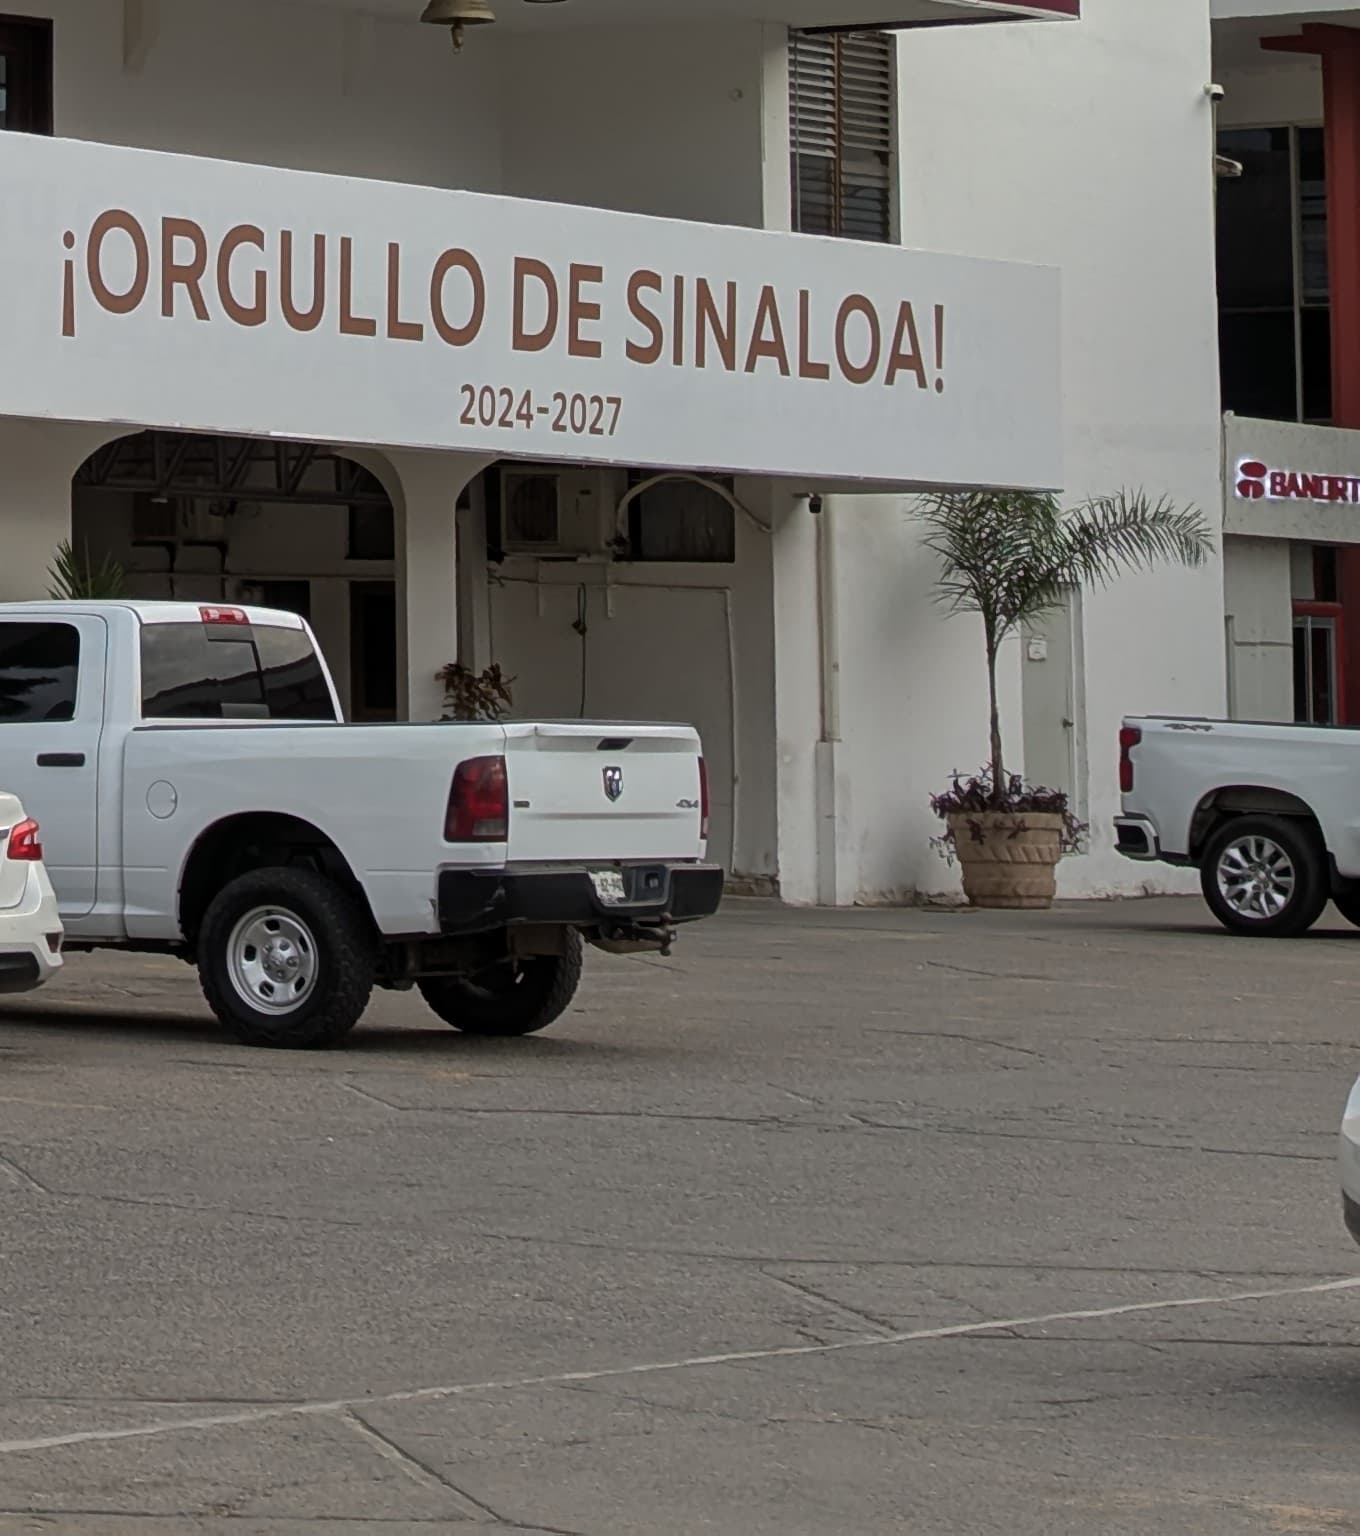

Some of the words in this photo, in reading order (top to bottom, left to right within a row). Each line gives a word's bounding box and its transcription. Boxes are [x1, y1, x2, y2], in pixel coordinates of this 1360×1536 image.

[60, 208, 485, 347] ¡ORGULLO
[512, 256, 603, 358] DE
[625, 268, 947, 394] SINALOA!
[460, 381, 623, 438] 2024-2027
[1270, 471, 1360, 502] BANORT
